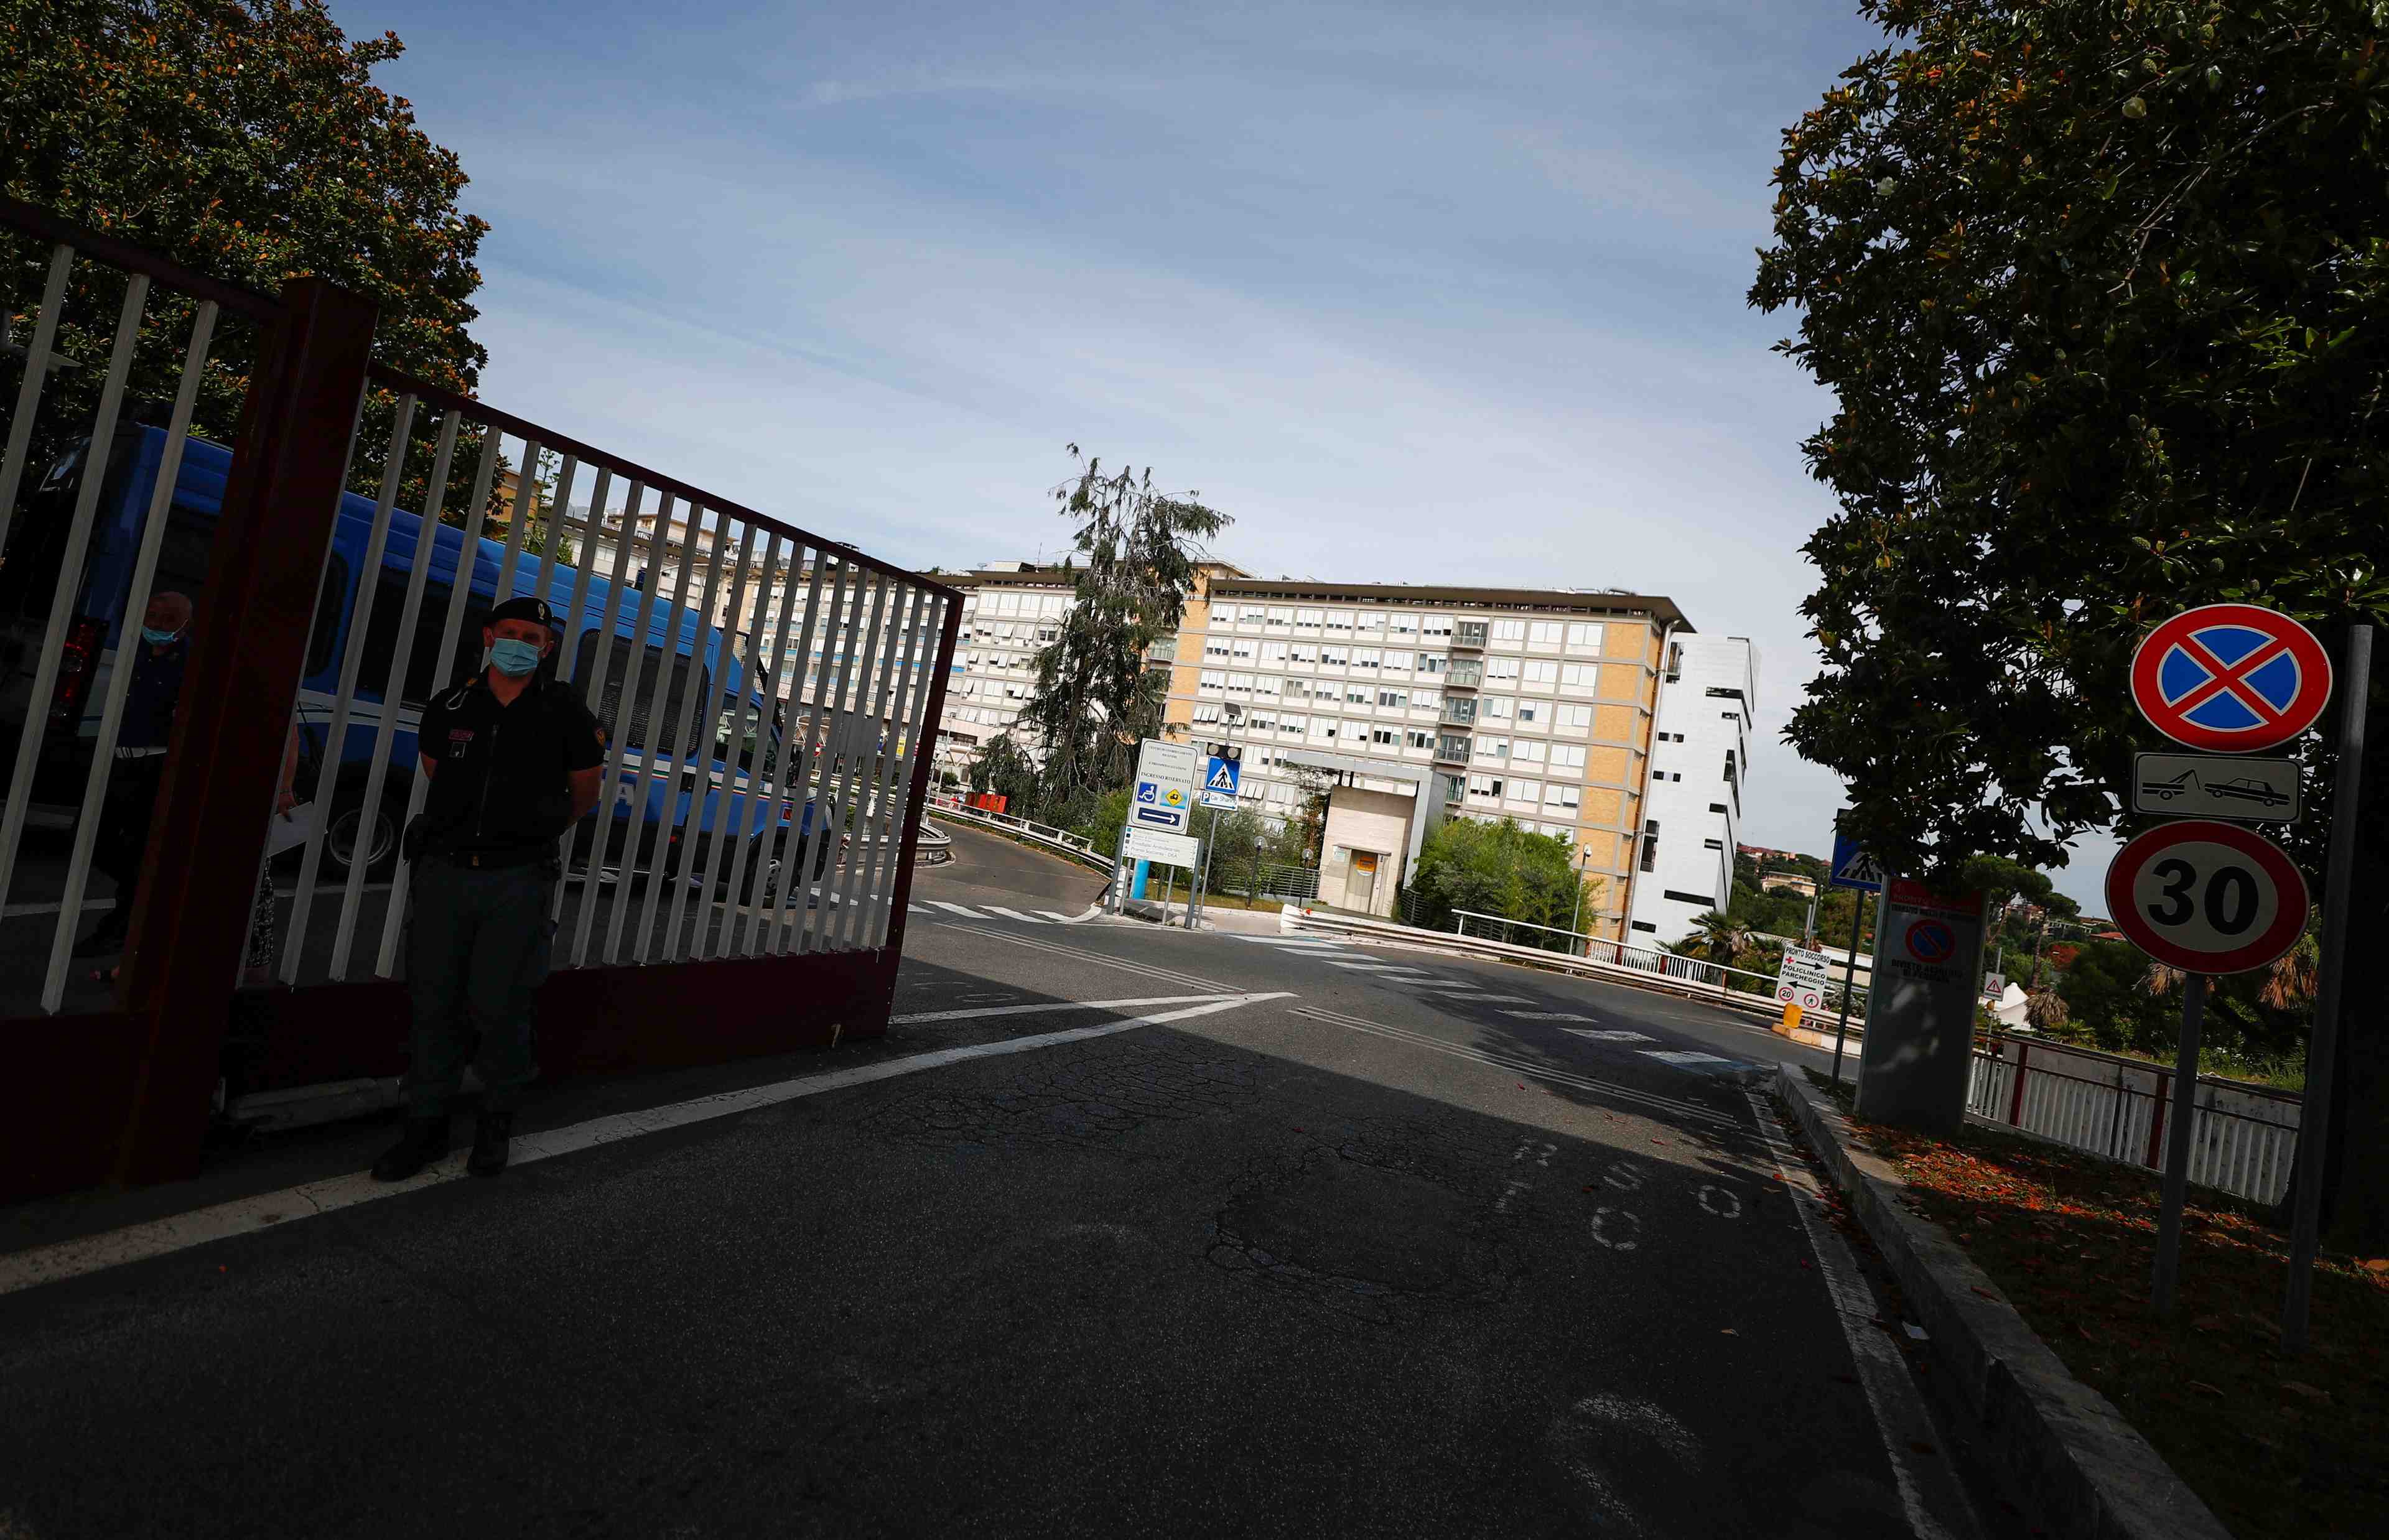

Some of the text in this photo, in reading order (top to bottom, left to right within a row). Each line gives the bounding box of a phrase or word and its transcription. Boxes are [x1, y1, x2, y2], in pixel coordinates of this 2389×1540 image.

[2147, 858, 2260, 935] 30
[1786, 947, 1830, 963] PRONTO SOCCORSO
[1781, 971, 1825, 985] PARCHEGGIO
[1783, 965, 1825, 979] POLICLINICO
